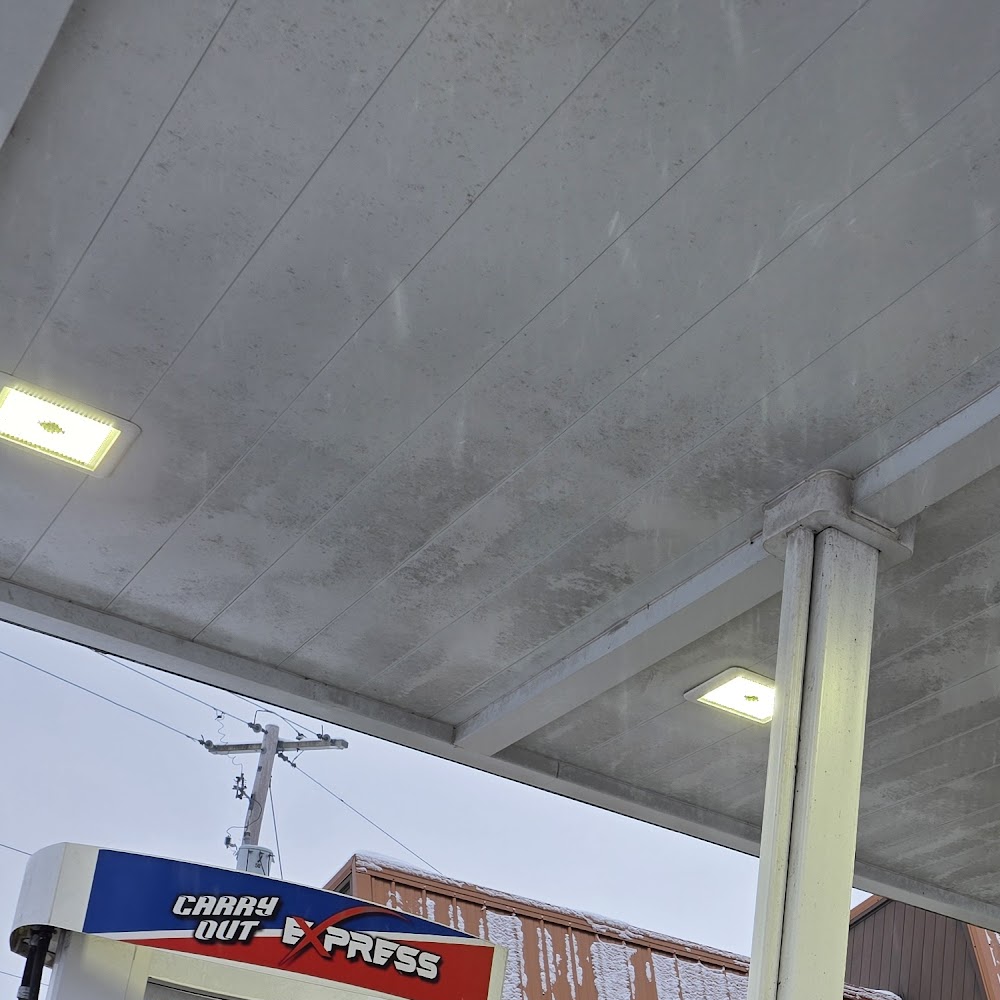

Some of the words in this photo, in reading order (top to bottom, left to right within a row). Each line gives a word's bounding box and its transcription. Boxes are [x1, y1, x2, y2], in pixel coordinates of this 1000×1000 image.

[172, 895, 279, 916] CARRY
[194, 920, 260, 940] OUT
[281, 915, 441, 980] EXPRESS
